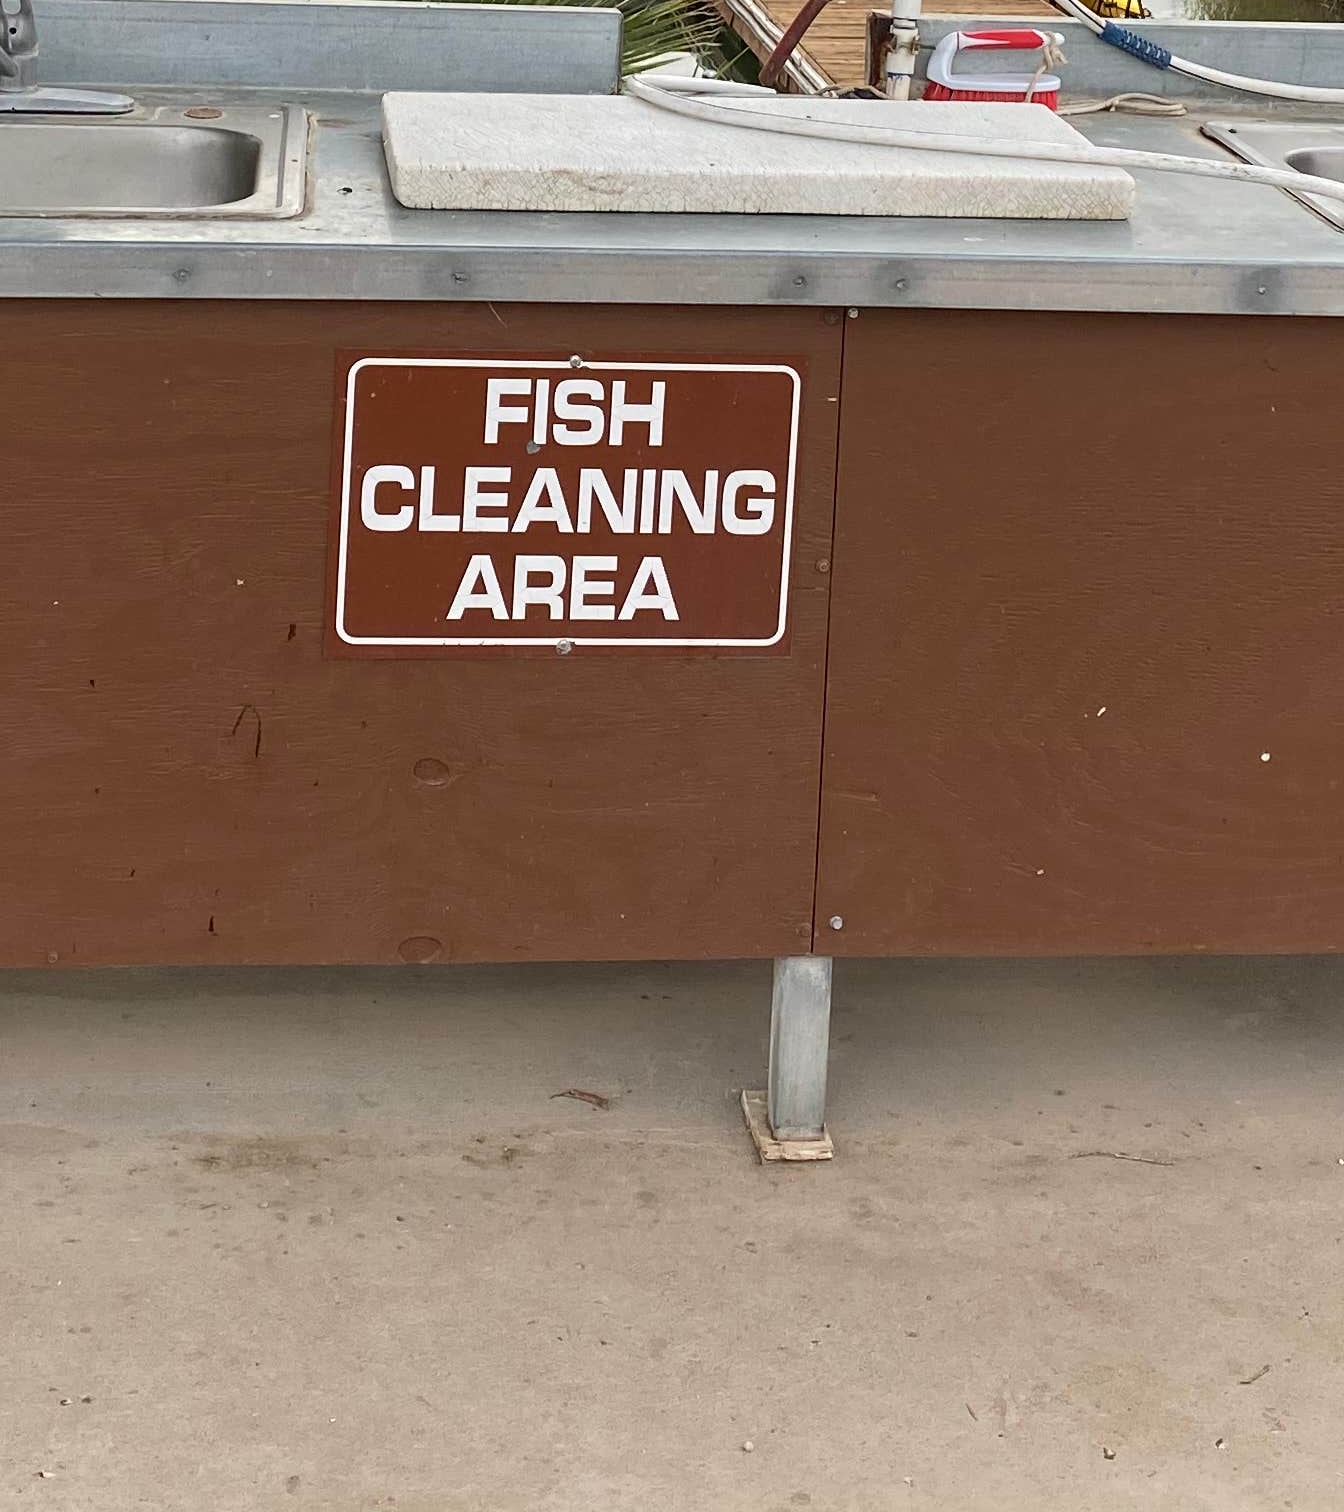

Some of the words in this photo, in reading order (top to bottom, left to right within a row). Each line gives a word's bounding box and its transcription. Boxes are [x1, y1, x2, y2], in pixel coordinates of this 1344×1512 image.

[483, 377, 666, 447] FISH
[360, 464, 776, 536] CLEANING
[446, 554, 680, 621] AREA
